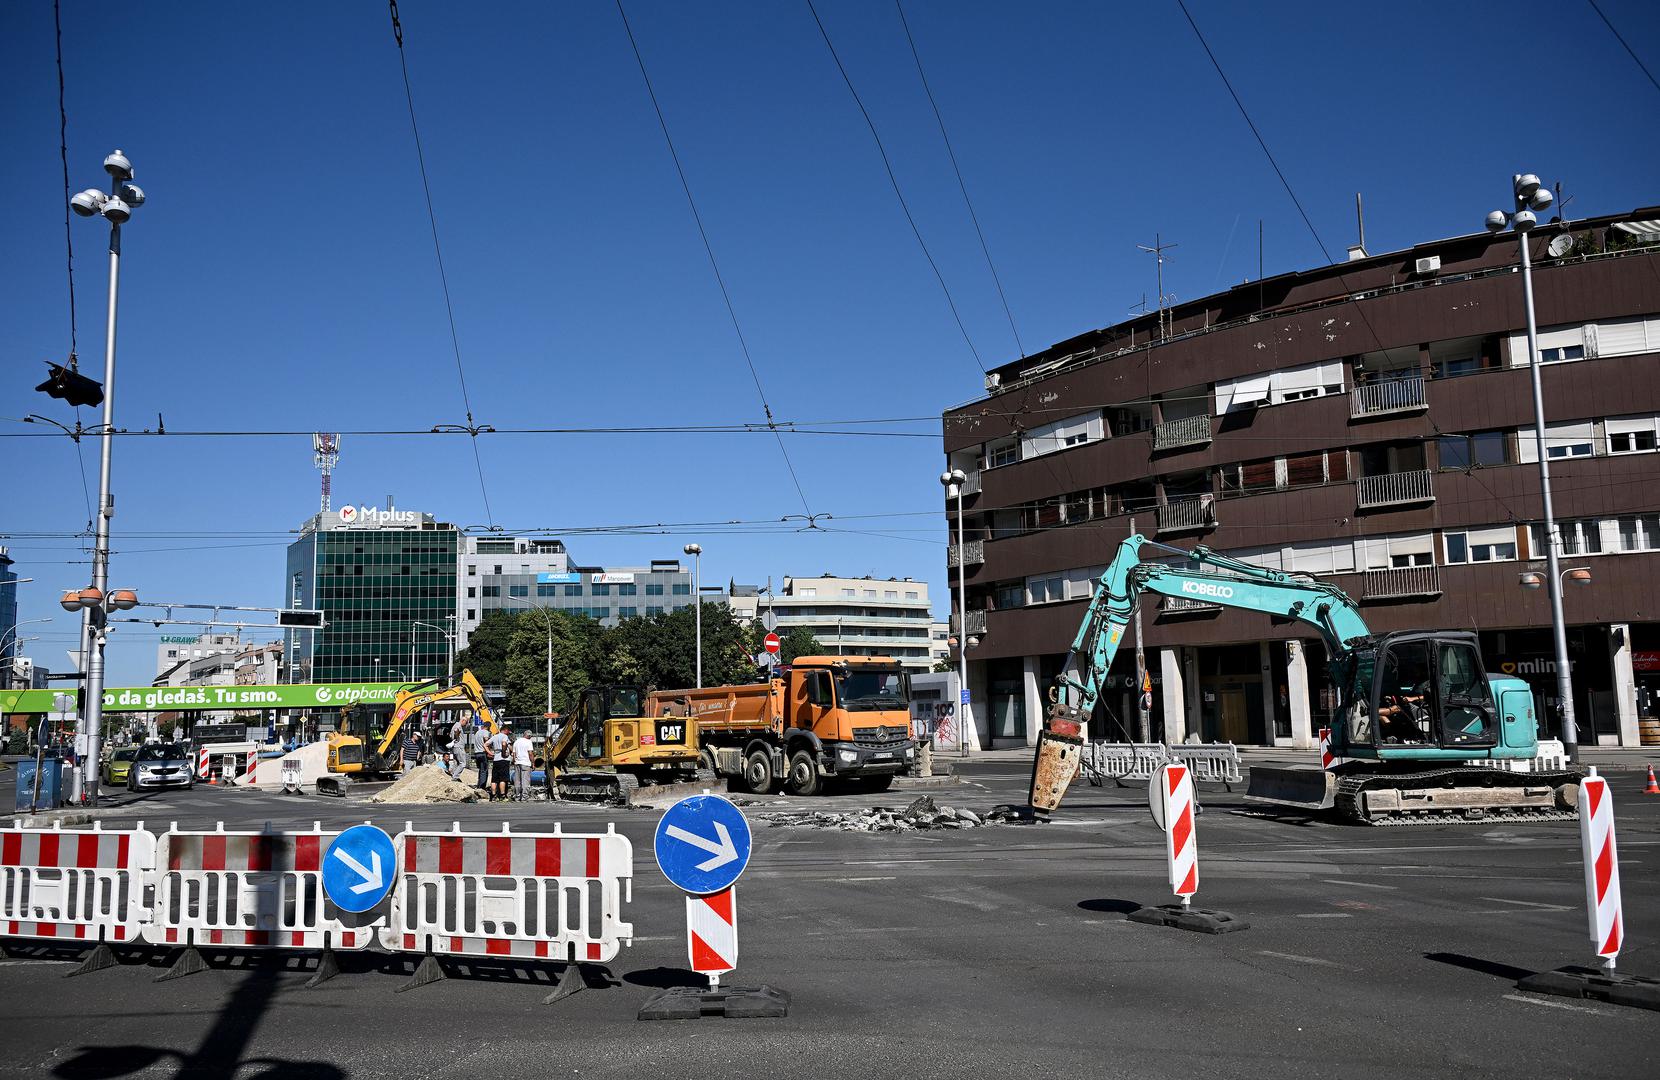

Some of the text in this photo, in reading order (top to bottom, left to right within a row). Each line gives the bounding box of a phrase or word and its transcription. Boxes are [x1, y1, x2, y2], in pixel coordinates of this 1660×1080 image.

[1182, 581, 1233, 598] KOBELCO
[1517, 658, 1577, 673] mlinr
[119, 690, 141, 705] da
[145, 688, 211, 708] gledaš.
[215, 689, 237, 703] Tu
[240, 691, 283, 703] smo.
[934, 703, 955, 717] 100
[661, 726, 681, 741] CAT
